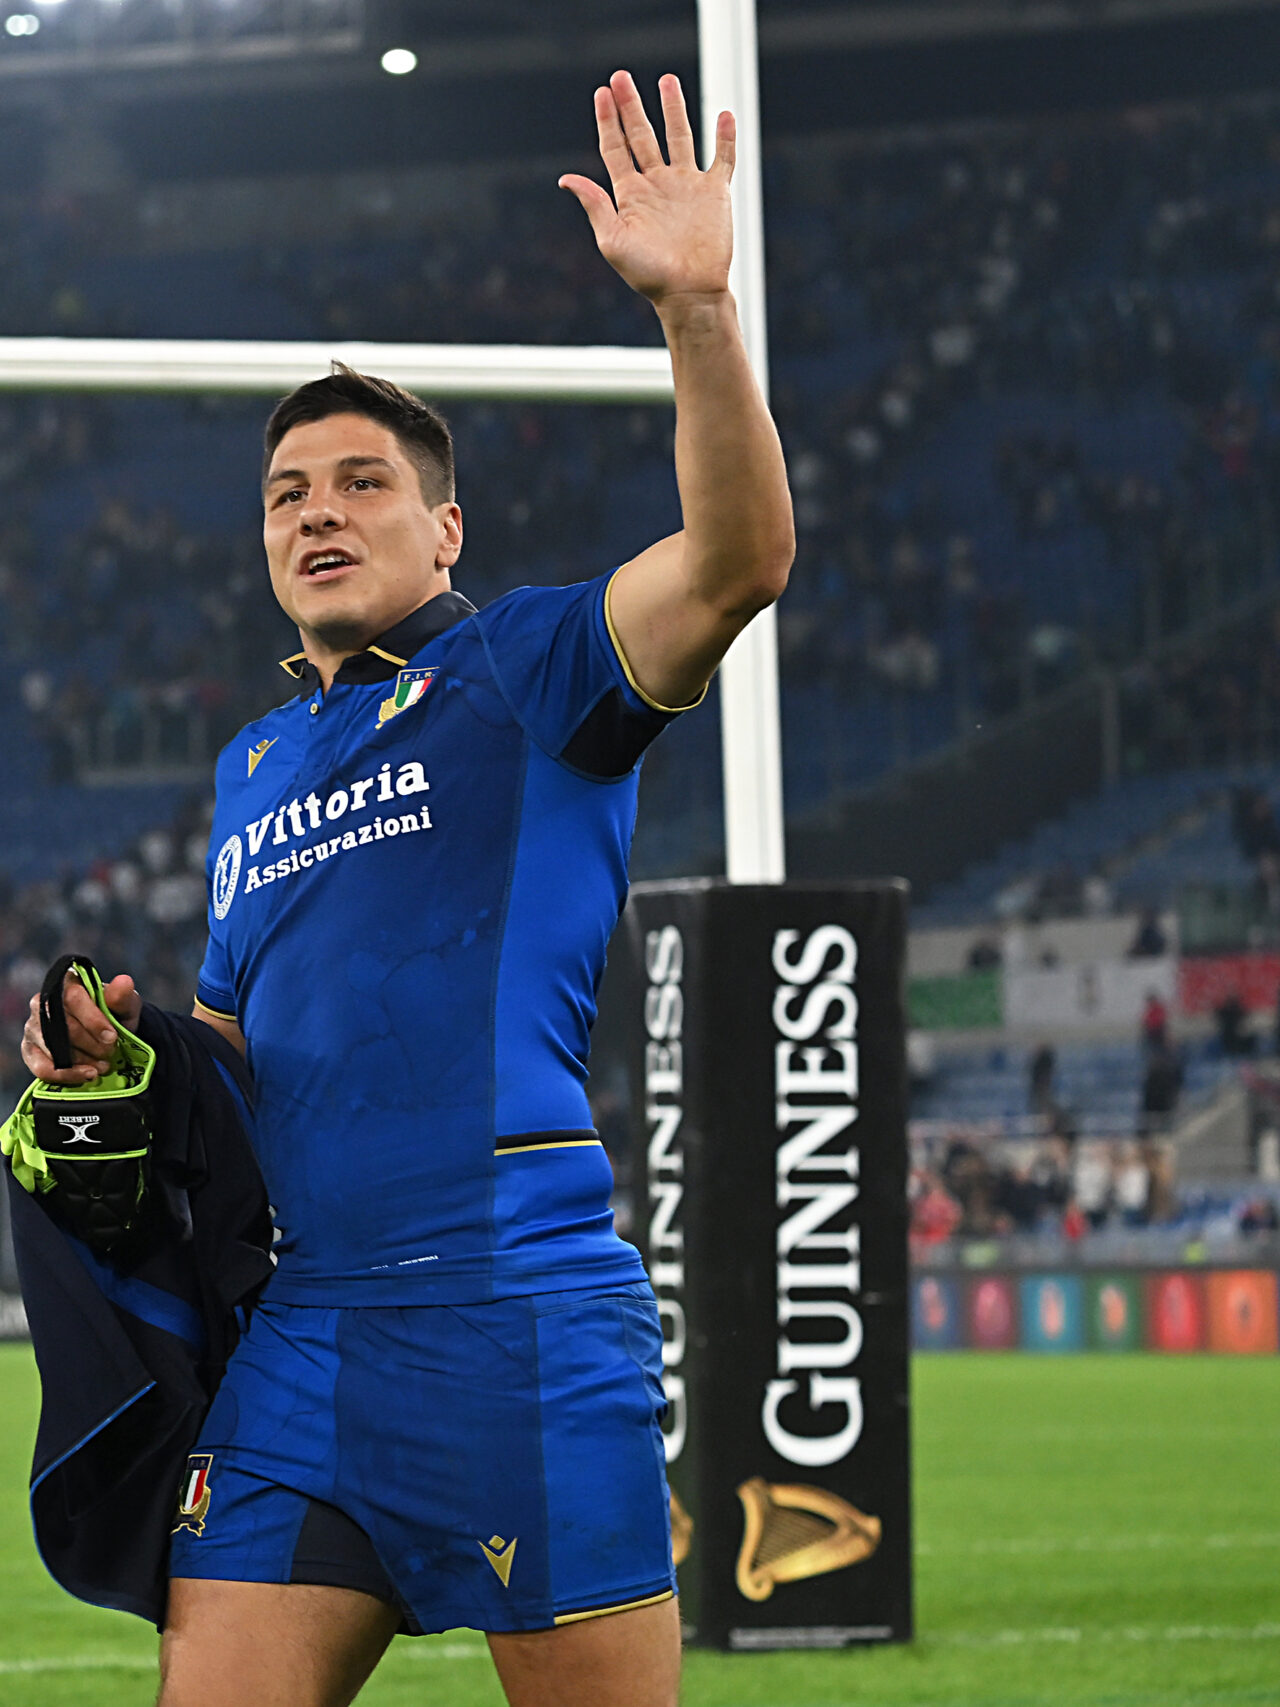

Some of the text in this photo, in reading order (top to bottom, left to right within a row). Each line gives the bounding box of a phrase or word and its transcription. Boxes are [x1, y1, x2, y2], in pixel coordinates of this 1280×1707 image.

[243, 806, 433, 894] Assicurazioni
[245, 761, 430, 857] Vittoria
[58, 1115, 100, 1123] GILBERT
[761, 923, 864, 1467] GUINNESS
